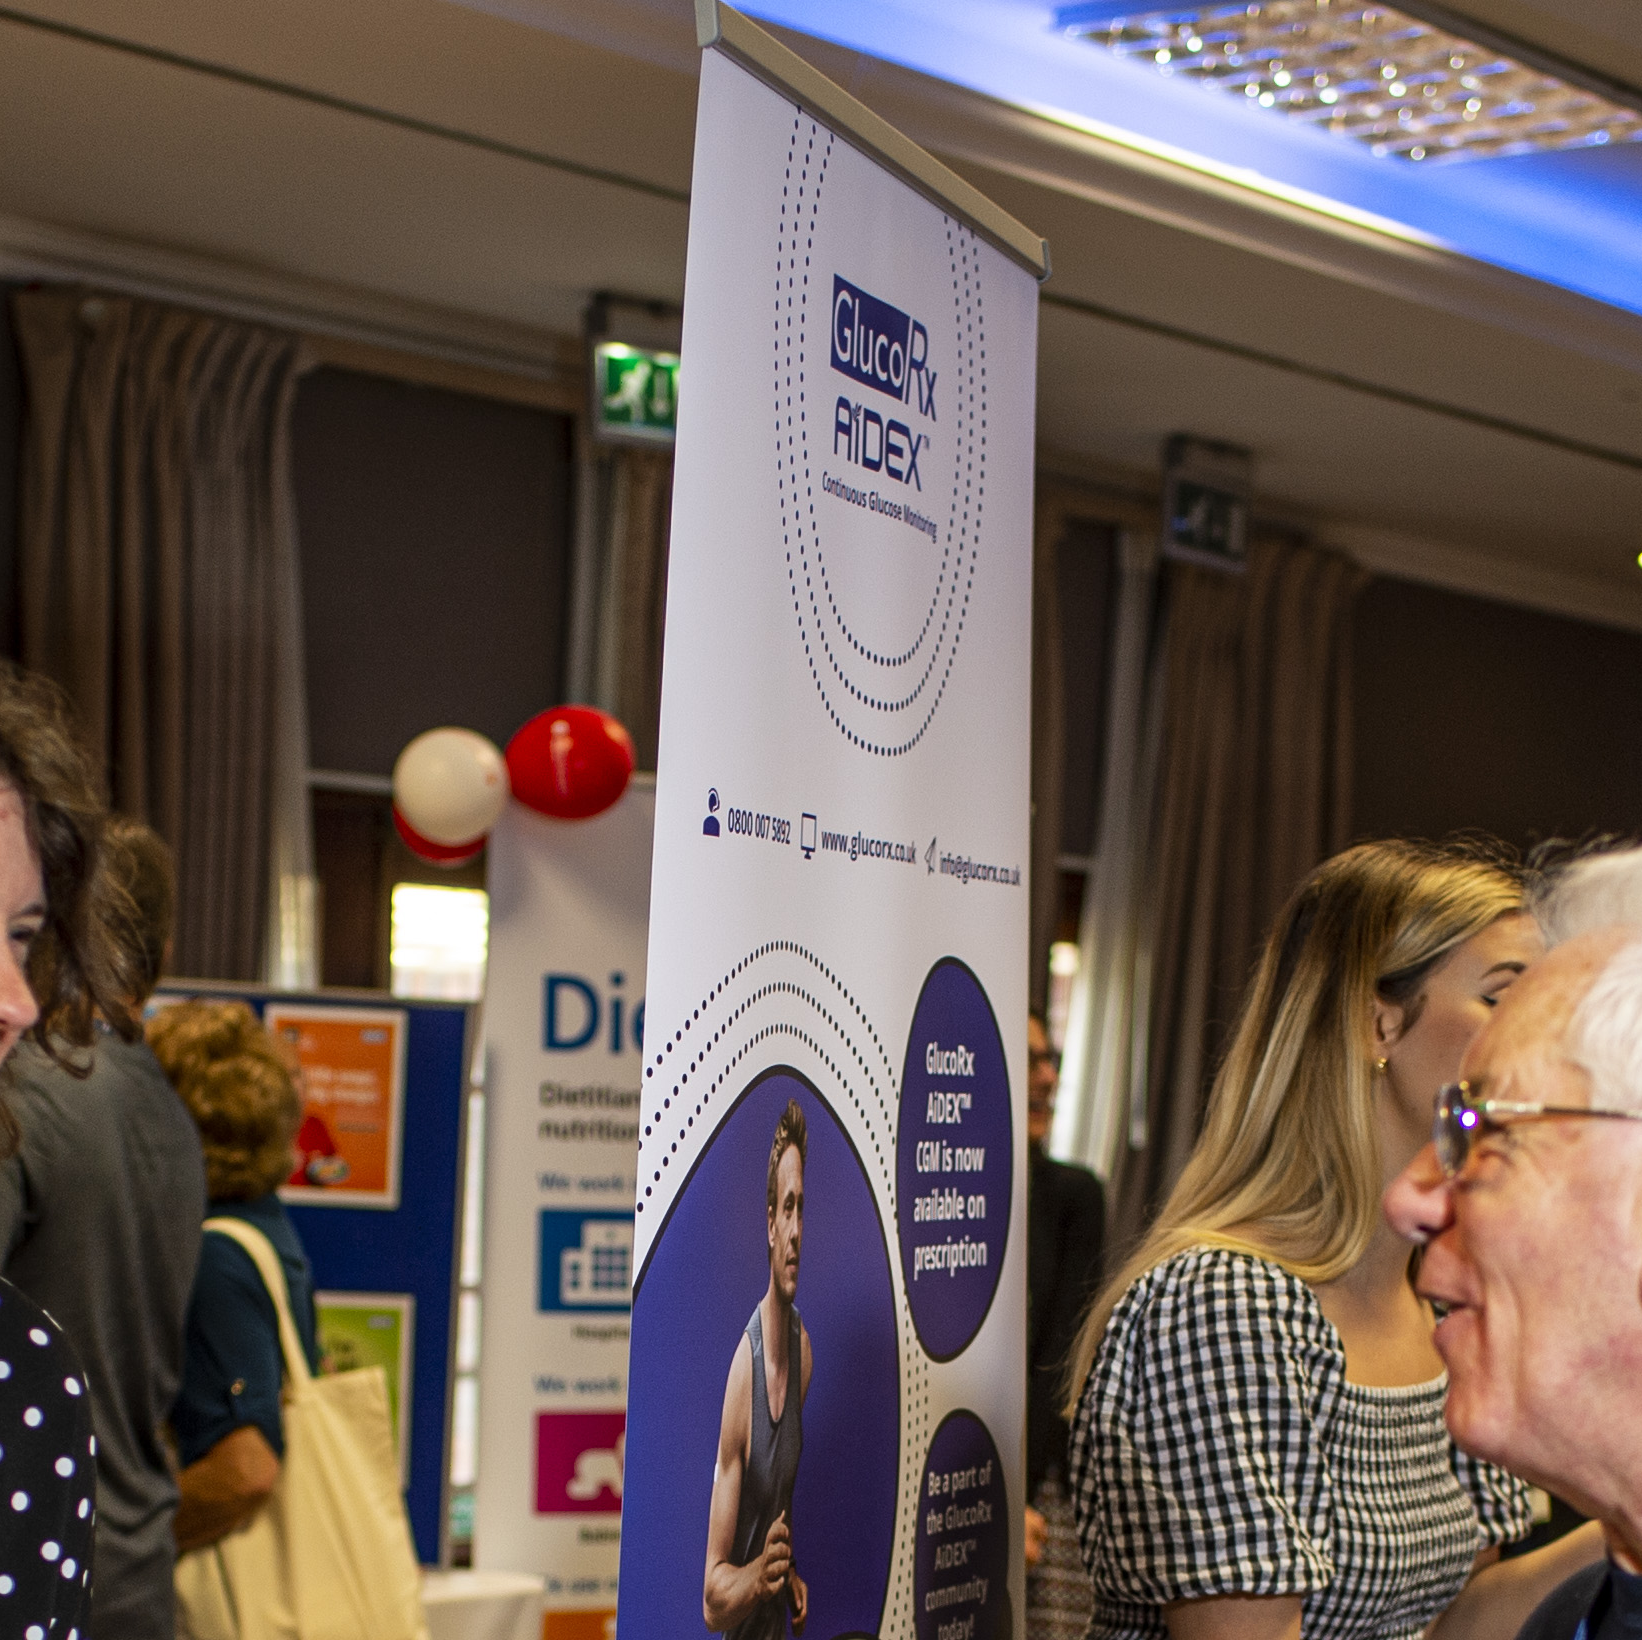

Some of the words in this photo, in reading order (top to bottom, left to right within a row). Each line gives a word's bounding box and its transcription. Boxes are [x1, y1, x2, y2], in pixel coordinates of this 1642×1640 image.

[834, 289, 937, 422] GlucoRx
[822, 471, 867, 508] Continuous
[868, 491, 902, 521] Glucose
[903, 503, 937, 544] Monitoring
[728, 808, 753, 836] 0800
[755, 813, 770, 841] 007
[771, 816, 791, 845] 5892
[821, 829, 917, 865] www.glucorx.co.uk
[940, 850, 1021, 887] info@glucorx.co.uk
[926, 1042, 975, 1077] GlucoRx
[915, 1141, 940, 1173] CGM
[942, 1140, 952, 1172] is
[954, 1147, 985, 1173] now
[914, 1188, 965, 1222] available
[967, 1194, 986, 1219] on
[913, 1235, 988, 1281] prescription
[928, 1471, 941, 1497] Be
[942, 1475, 950, 1493] a
[952, 1466, 977, 1499] part
[978, 1459, 993, 1486] of
[926, 1508, 944, 1536] the
[945, 1500, 993, 1531] GlucoRx
[925, 1576, 989, 1613] community
